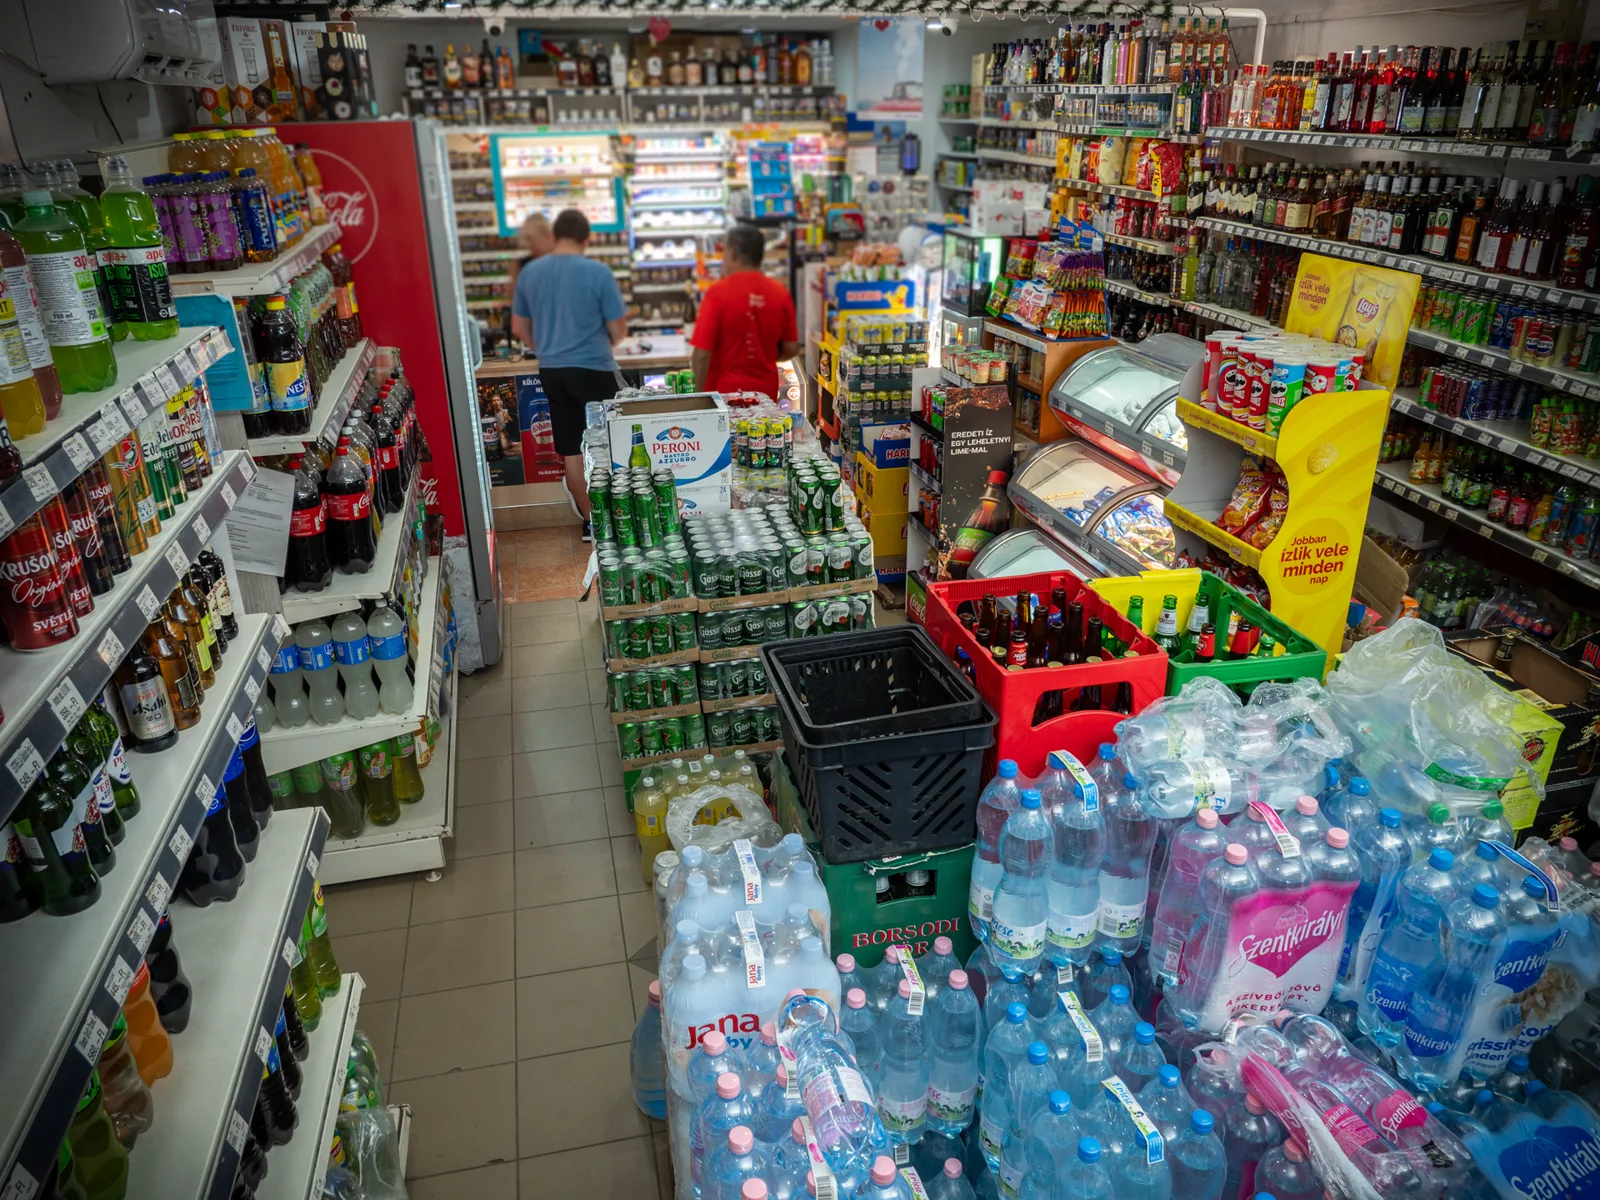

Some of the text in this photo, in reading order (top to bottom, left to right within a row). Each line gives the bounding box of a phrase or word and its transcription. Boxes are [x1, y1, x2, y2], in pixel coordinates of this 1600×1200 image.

[1313, 285, 1331, 295] vele
[1298, 292, 1328, 306] minden
[1356, 298, 1380, 319] Lay's
[718, 415, 726, 424] 24
[951, 428, 993, 439] EREDETI ÍZ
[652, 441, 701, 455] PERONI
[951, 436, 1011, 448] EGY LEHELETNYI
[950, 447, 989, 456] LIME-MAL
[658, 456, 697, 465] AZZURRO
[719, 486, 727, 494] 24
[1291, 535, 1327, 546] Jobban
[1280, 543, 1349, 563] ízlik vele
[1282, 561, 1344, 578] minden
[1309, 575, 1329, 585] nap
[852, 917, 960, 949] BORSODI
[1228, 904, 1347, 978] Szentkirályi
[1402, 1024, 1459, 1052] zentkirályi
